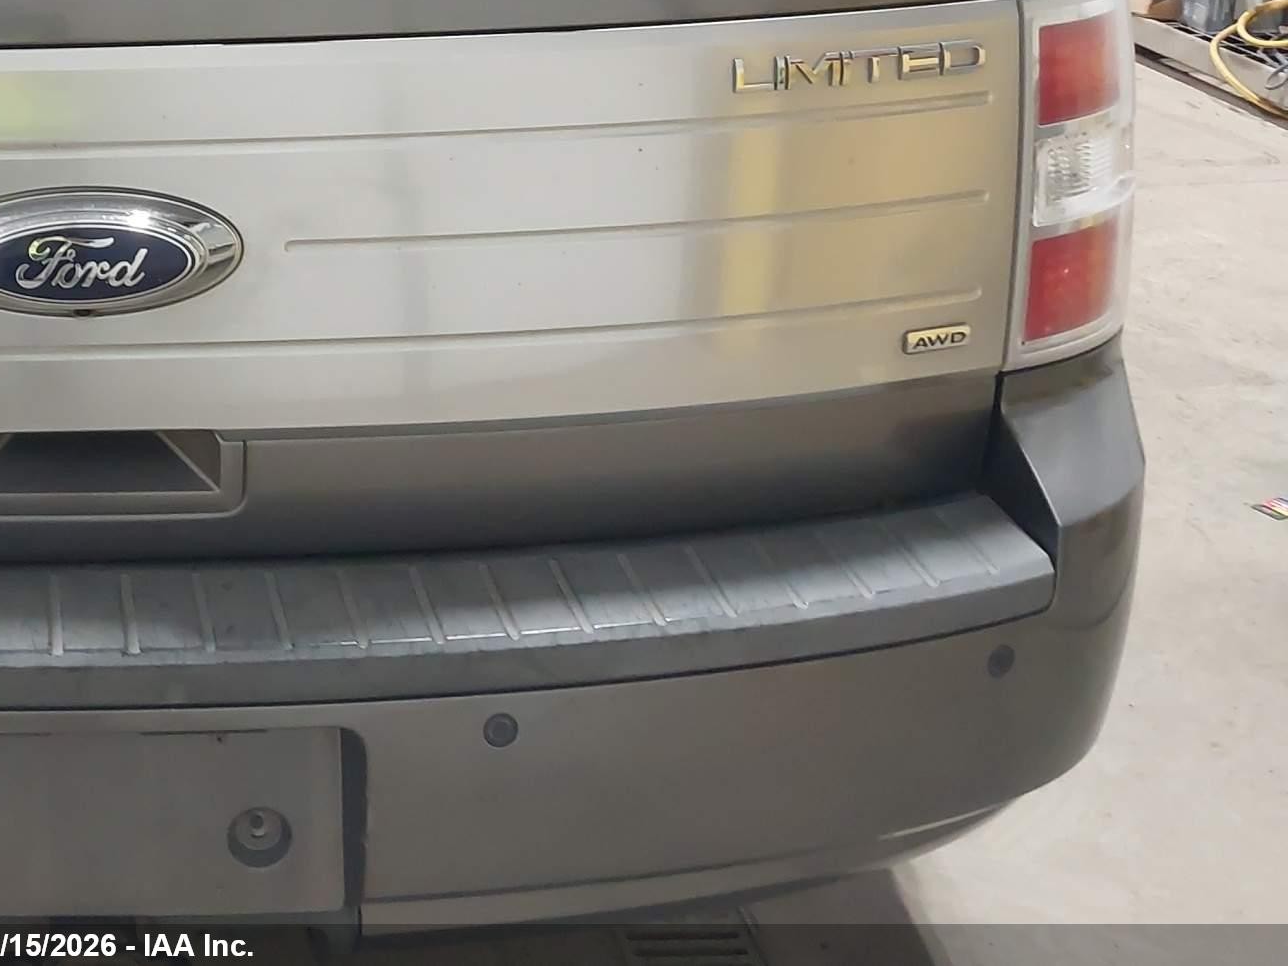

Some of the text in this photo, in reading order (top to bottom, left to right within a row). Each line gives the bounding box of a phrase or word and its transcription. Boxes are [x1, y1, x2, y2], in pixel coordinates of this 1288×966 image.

[732, 39, 987, 93] LIMITED
[15, 234, 149, 290] Ford
[913, 331, 967, 350] AWD
